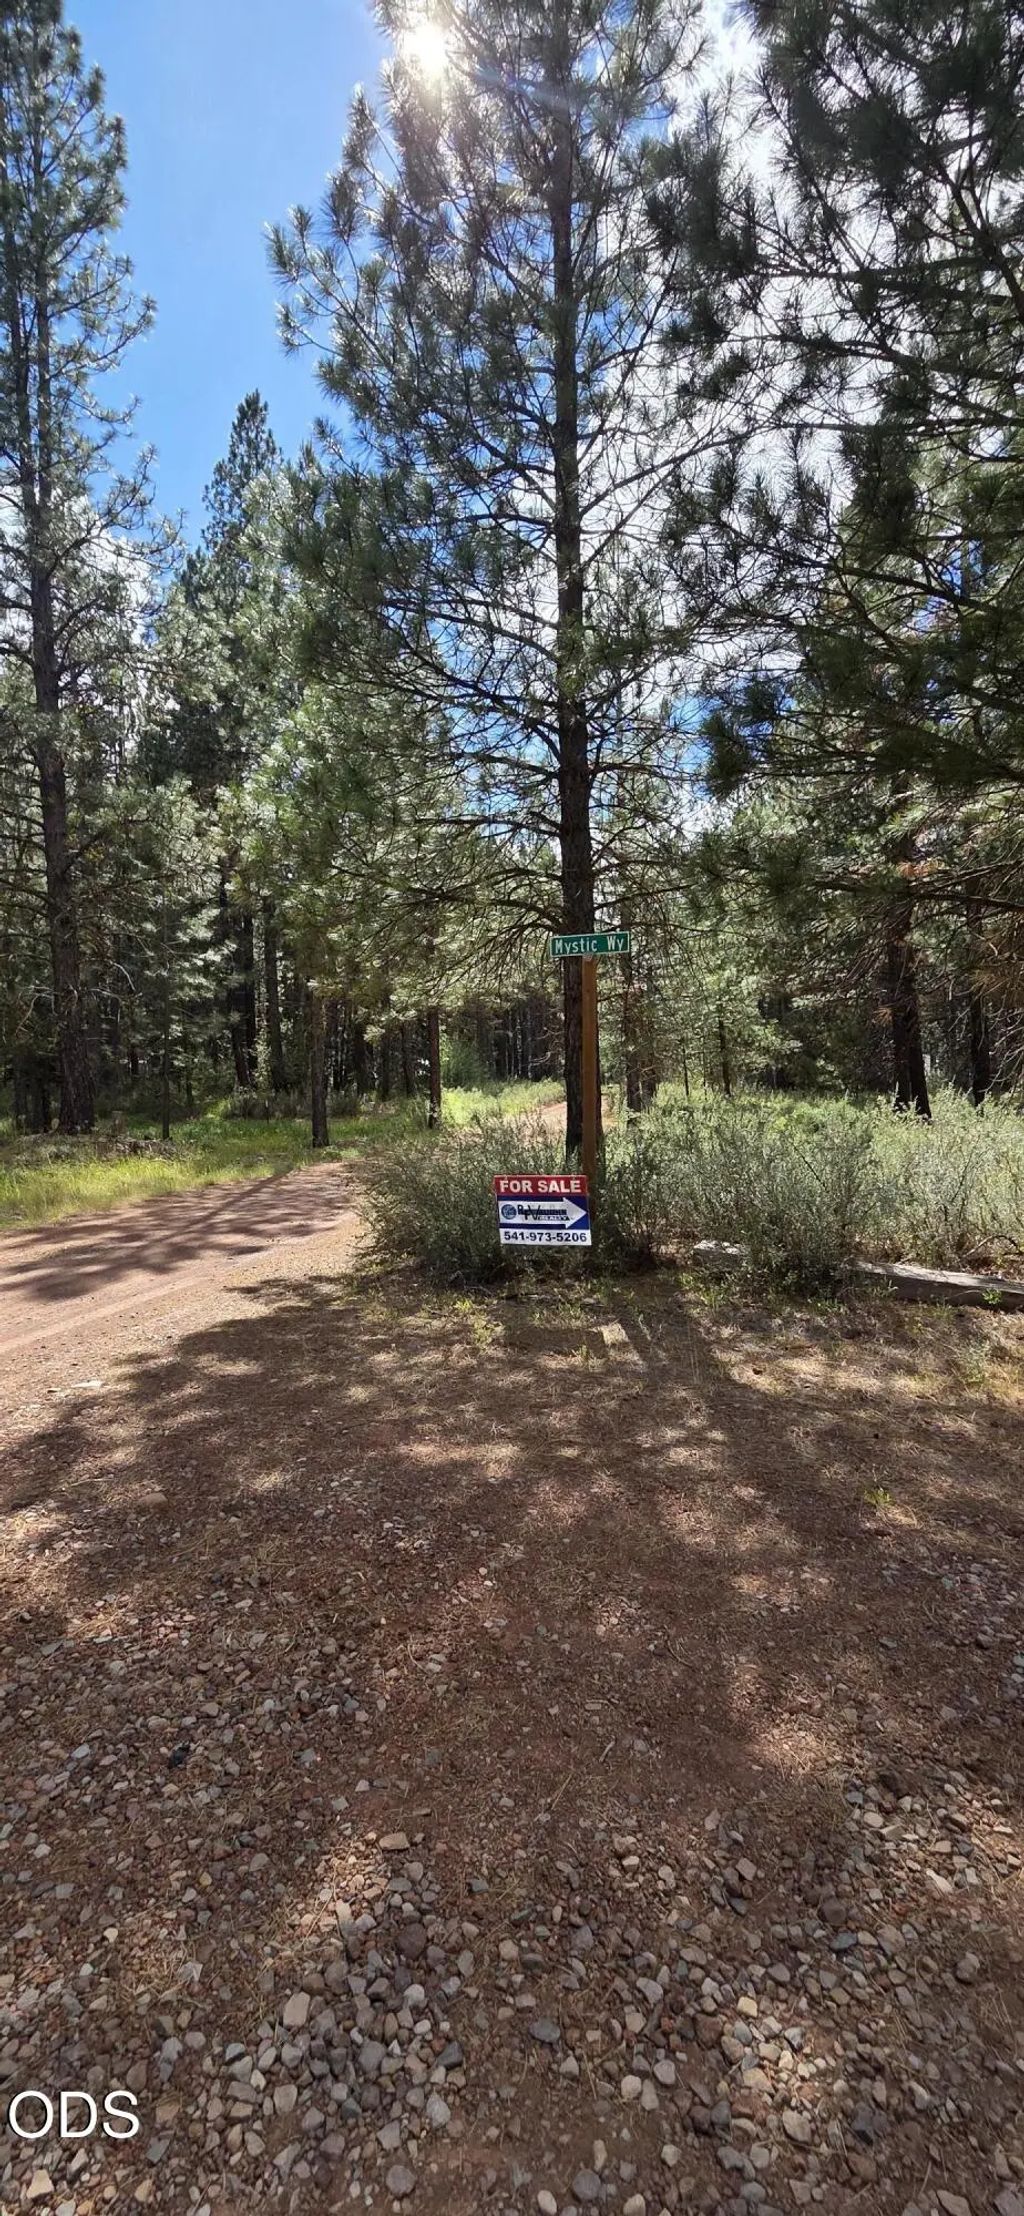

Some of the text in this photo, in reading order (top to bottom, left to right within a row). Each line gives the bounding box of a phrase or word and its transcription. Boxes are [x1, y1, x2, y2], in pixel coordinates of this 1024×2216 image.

[555, 935, 624, 955] Mystic Wy
[499, 1180, 582, 1193] FOR SALE
[504, 1231, 587, 1242] 541-973-5206
